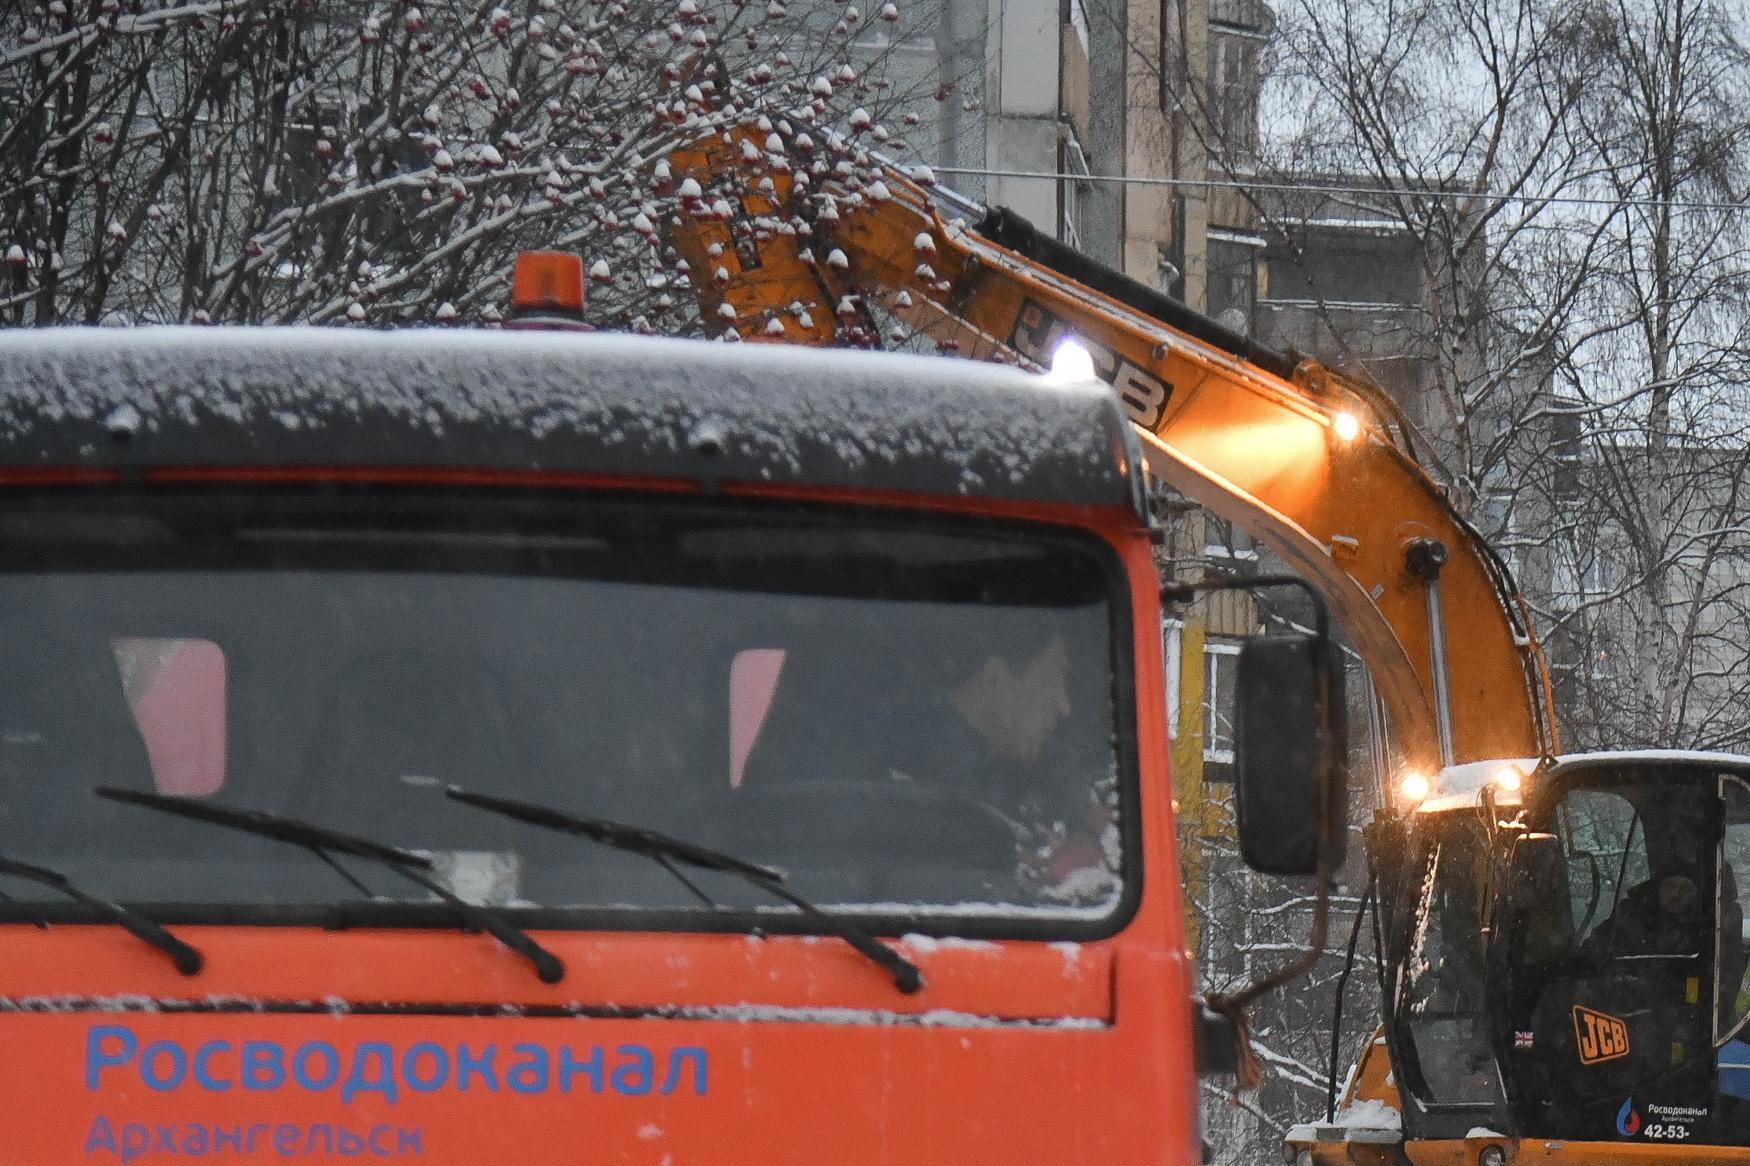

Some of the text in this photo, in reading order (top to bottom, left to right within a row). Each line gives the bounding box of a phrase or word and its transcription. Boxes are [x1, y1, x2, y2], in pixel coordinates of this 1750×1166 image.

[1582, 1012, 1626, 1058] JCB
[85, 1024, 709, 1105] Росводоканал
[84, 1114, 424, 1166] Архангельск
